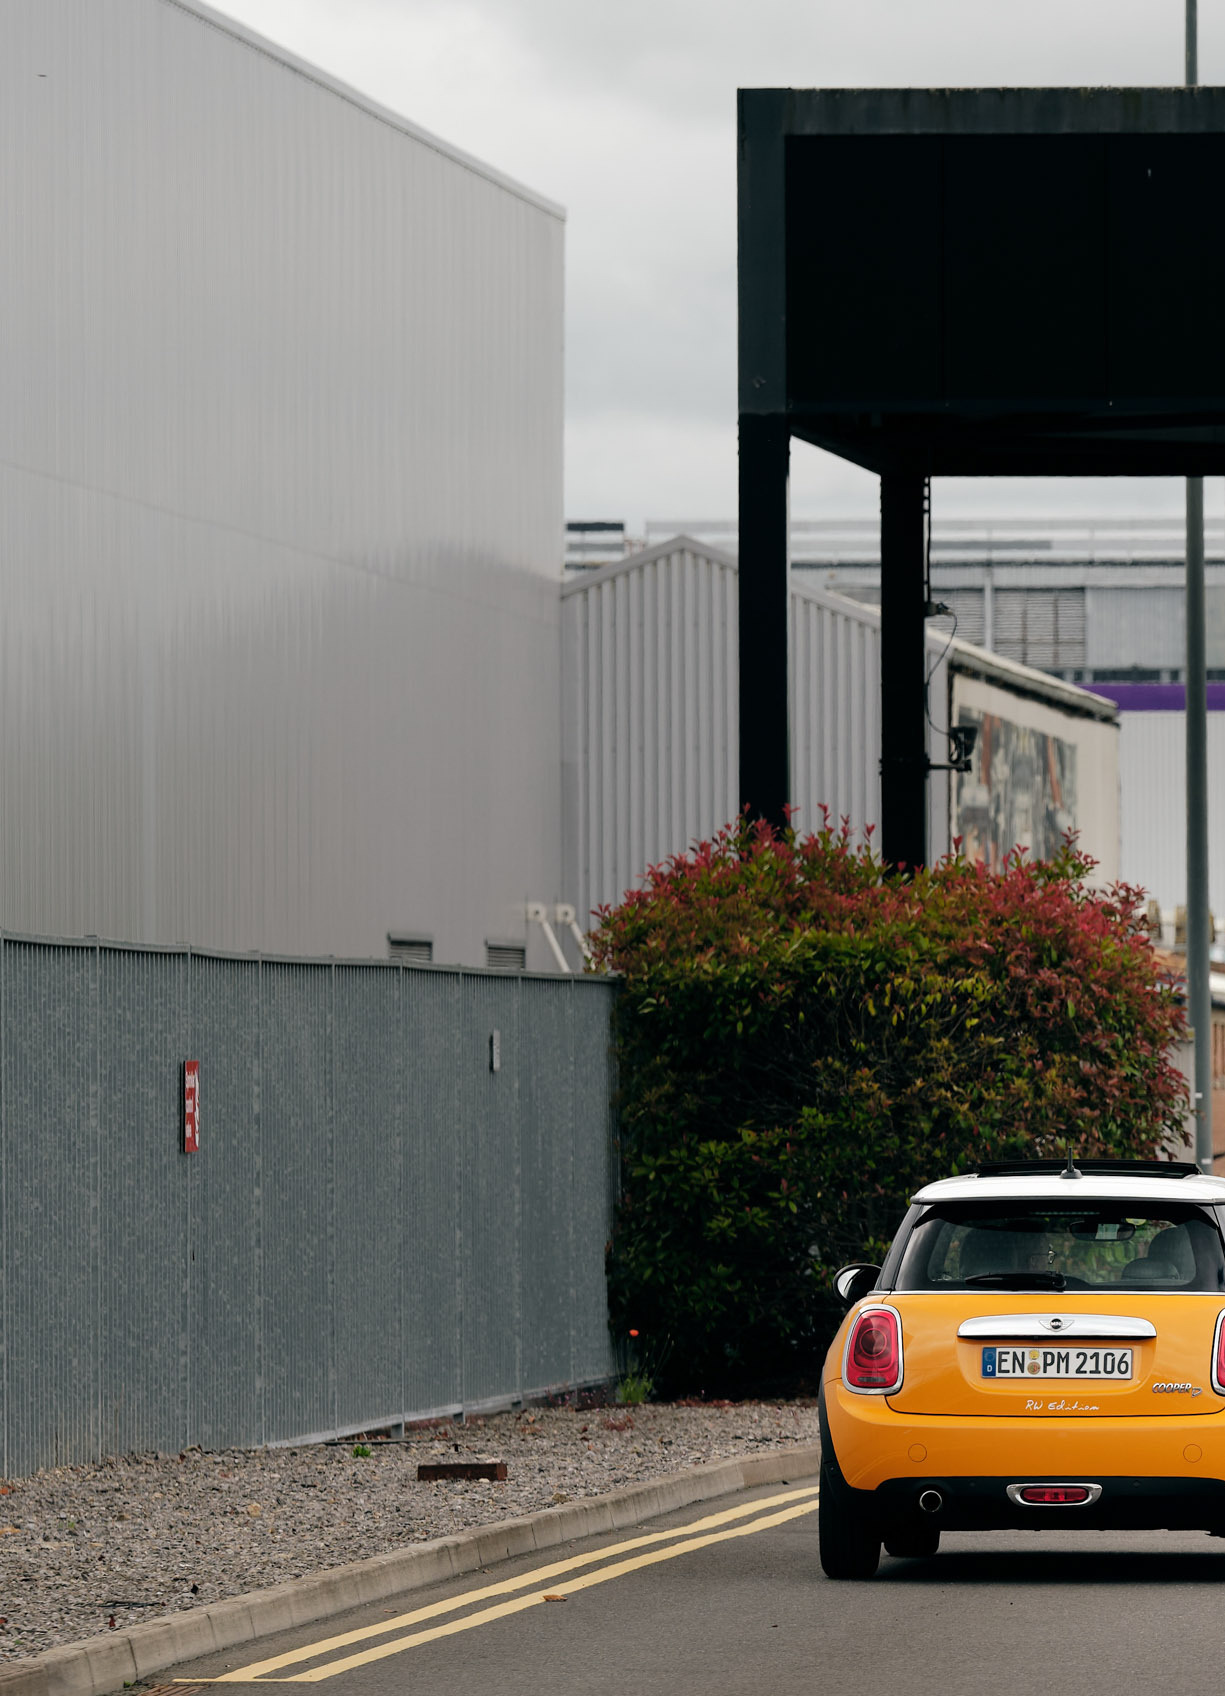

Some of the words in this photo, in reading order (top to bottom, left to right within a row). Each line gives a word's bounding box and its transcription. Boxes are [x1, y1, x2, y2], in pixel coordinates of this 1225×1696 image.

[986, 1364, 993, 1373] D
[998, 1351, 1025, 1374] EN
[1043, 1351, 1069, 1374] PM
[1075, 1352, 1129, 1375] 2106
[1152, 1382, 1192, 1394] COOPER
[1025, 1399, 1043, 1411] RW
[1048, 1399, 1100, 1411] Edition
